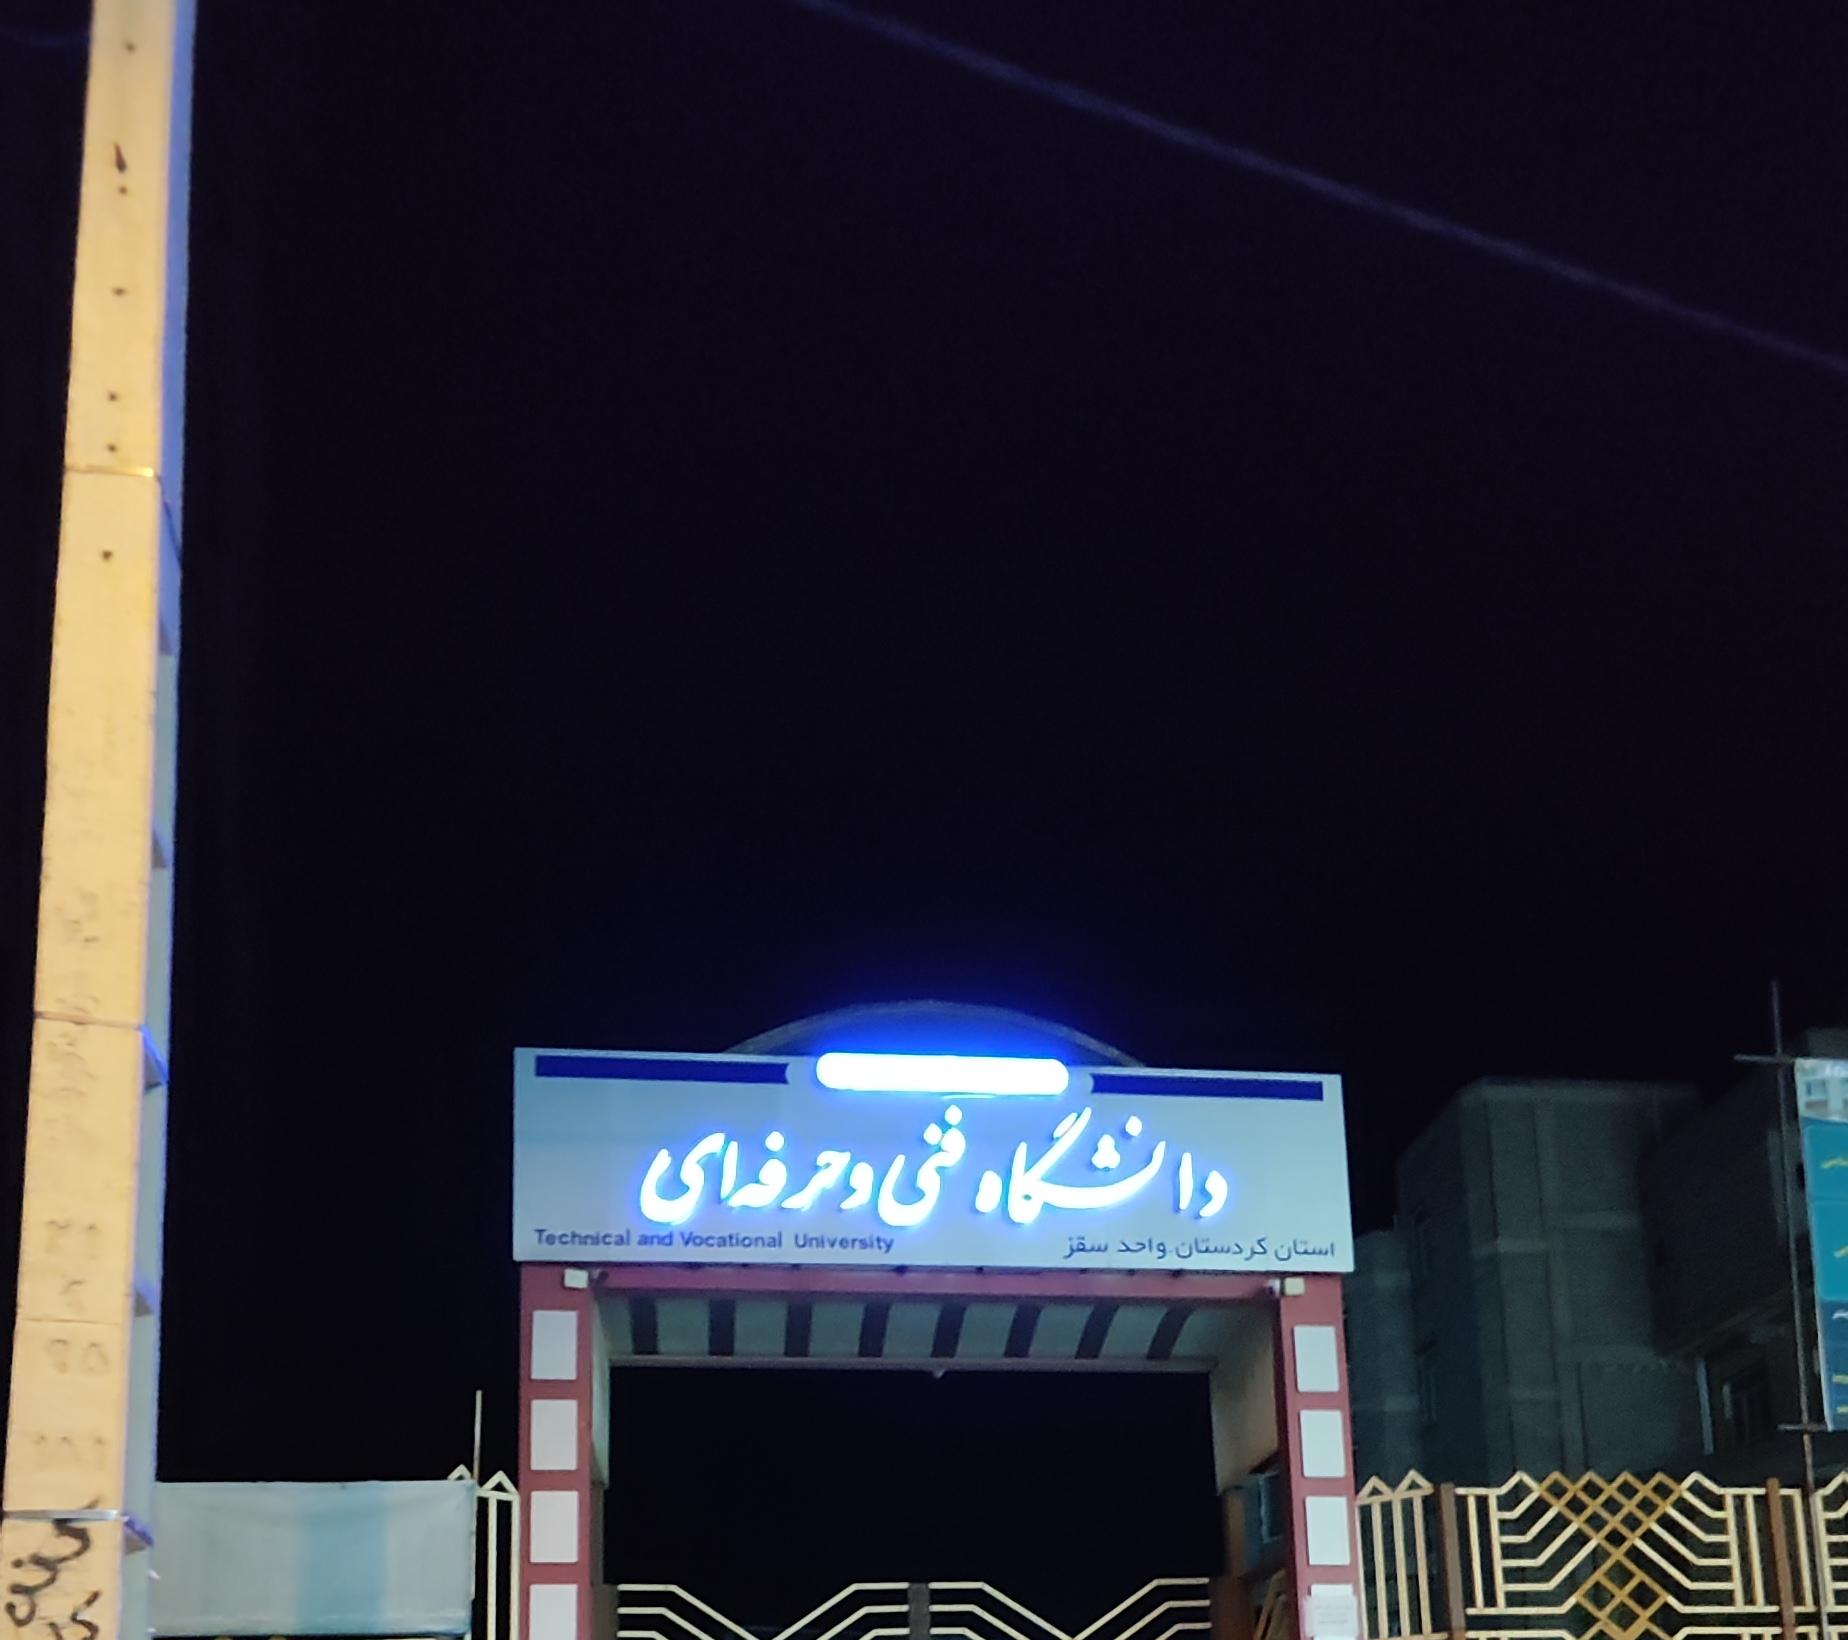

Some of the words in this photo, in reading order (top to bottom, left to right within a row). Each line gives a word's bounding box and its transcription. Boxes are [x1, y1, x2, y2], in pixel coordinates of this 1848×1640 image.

[877, 1104, 966, 1227] فنی
[974, 1106, 1229, 1225] دانشگاه
[533, 1228, 631, 1247] Technical
[637, 1230, 674, 1247] and
[680, 1230, 783, 1249] Vocational
[794, 1232, 895, 1255] University
[1063, 1235, 1109, 1260] سقز
[1116, 1237, 1167, 1260] واحد
[1175, 1236, 1267, 1262] کردستان
[1273, 1239, 1336, 1262] استان
